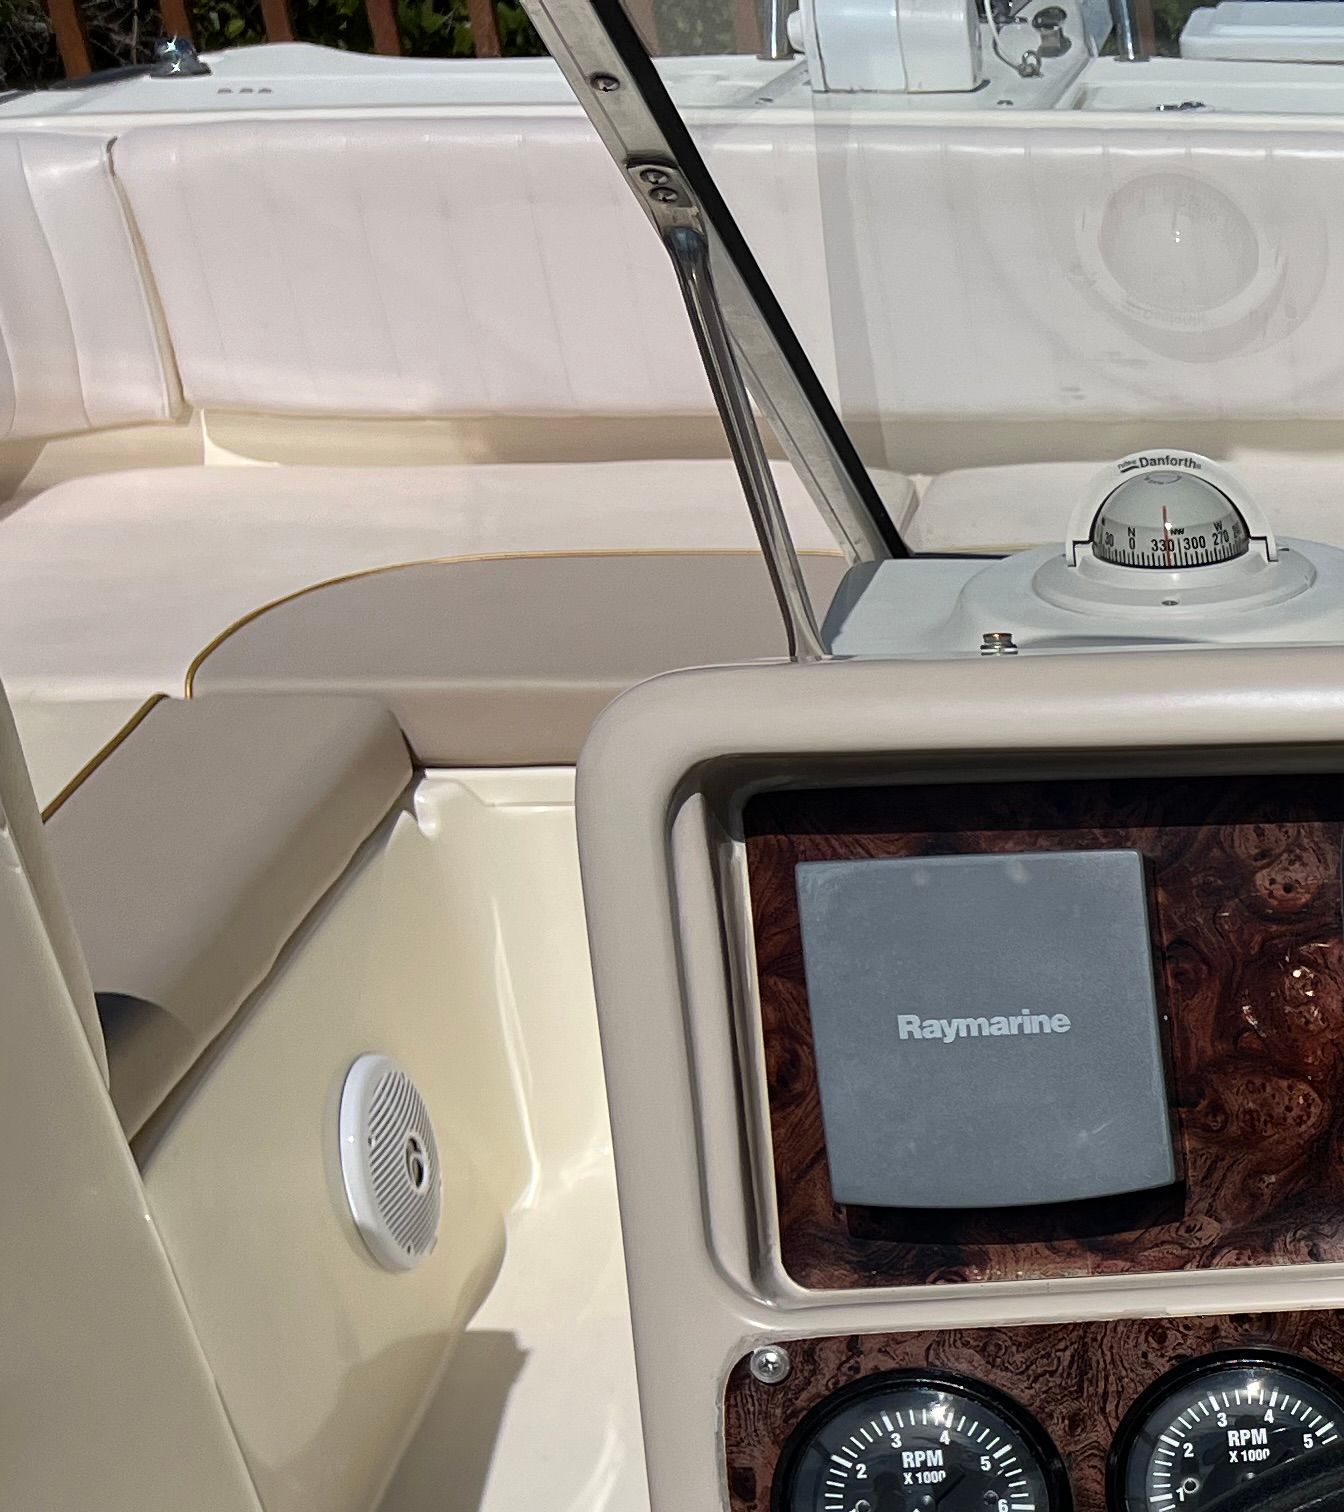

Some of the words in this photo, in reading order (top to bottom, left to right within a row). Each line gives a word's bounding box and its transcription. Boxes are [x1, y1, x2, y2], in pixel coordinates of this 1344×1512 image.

[1139, 455, 1197, 469] Danforth
[1127, 526, 1136, 537] N
[1211, 529, 1230, 546] 270
[1128, 538, 1136, 550] 0
[1150, 538, 1175, 552] 330
[1183, 535, 1206, 551] 300
[896, 1009, 1071, 1044] Raymarine
[1216, 1412, 1228, 1428] 3
[1263, 1408, 1275, 1424] 4
[891, 1432, 902, 1449] 3
[939, 1429, 950, 1445] 4
[1227, 1427, 1268, 1447] RPM
[1303, 1433, 1314, 1449] 5
[1183, 1442, 1194, 1458] 2
[1228, 1450, 1239, 1463] X
[1240, 1448, 1271, 1462] 1000
[901, 1449, 944, 1469] RPM
[980, 1456, 992, 1471] 5
[855, 1464, 867, 1479] 2
[903, 1472, 913, 1485] X
[915, 1470, 946, 1484] 1000
[1175, 1486, 1185, 1502] 1
